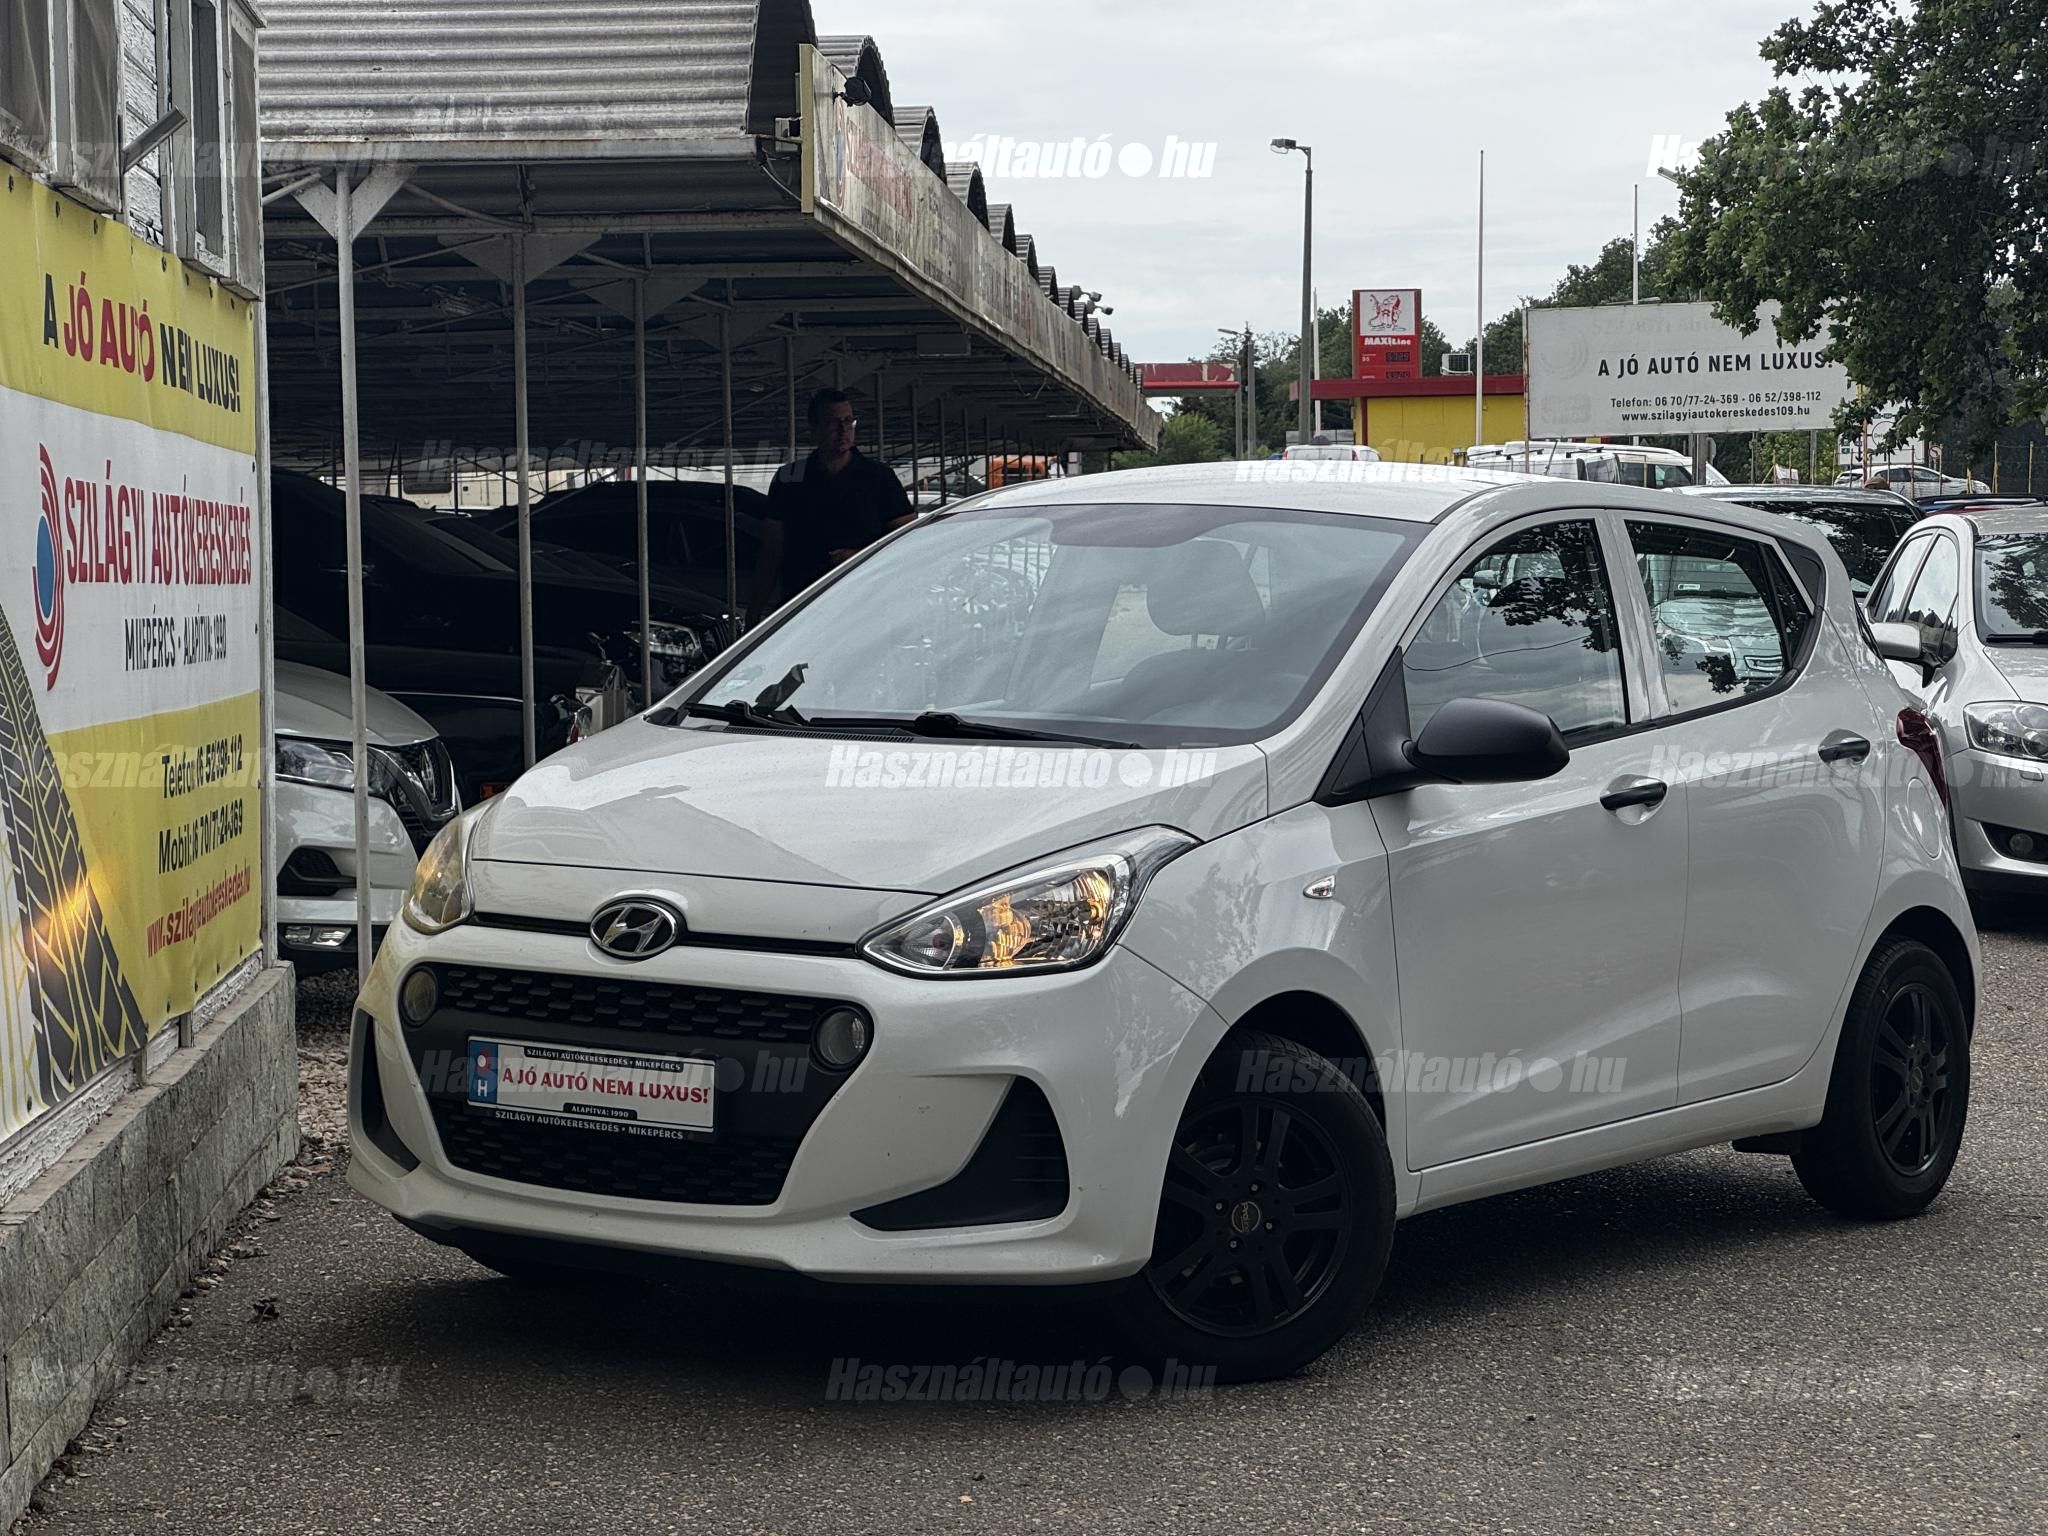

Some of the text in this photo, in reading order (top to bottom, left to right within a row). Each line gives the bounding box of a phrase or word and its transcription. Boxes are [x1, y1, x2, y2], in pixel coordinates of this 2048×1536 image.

[44, 272, 58, 348] A
[64, 272, 93, 362] JÓ
[195, 340, 241, 413] LUXUS!
[1598, 360, 1610, 376] A
[1617, 354, 1638, 378] JÓ
[1648, 352, 1699, 374] AUTÓ
[1708, 354, 1750, 372] NEM
[1611, 391, 1821, 408] Telefon: 06 70/77-24-369 06 52/398-112
[1622, 406, 1810, 422] www.szilagyiautokereskedes109.hu
[64, 460, 252, 586] SZILÁGYI AUTÓKERESKEDÉS
[526, 1048, 680, 1070] SZILÁGYI AUTÓKERESKEDÉS MIKEPÉRCS
[478, 1080, 488, 1097] H
[502, 1066, 709, 1104] A JÓ AUTÓ NEM LUXUS!
[572, 1104, 629, 1118] ALAPÍTVA: 1990
[496, 1110, 684, 1140] SZILÁGYI AUTÓKERESKEDÉS MIKEPÉRCS
